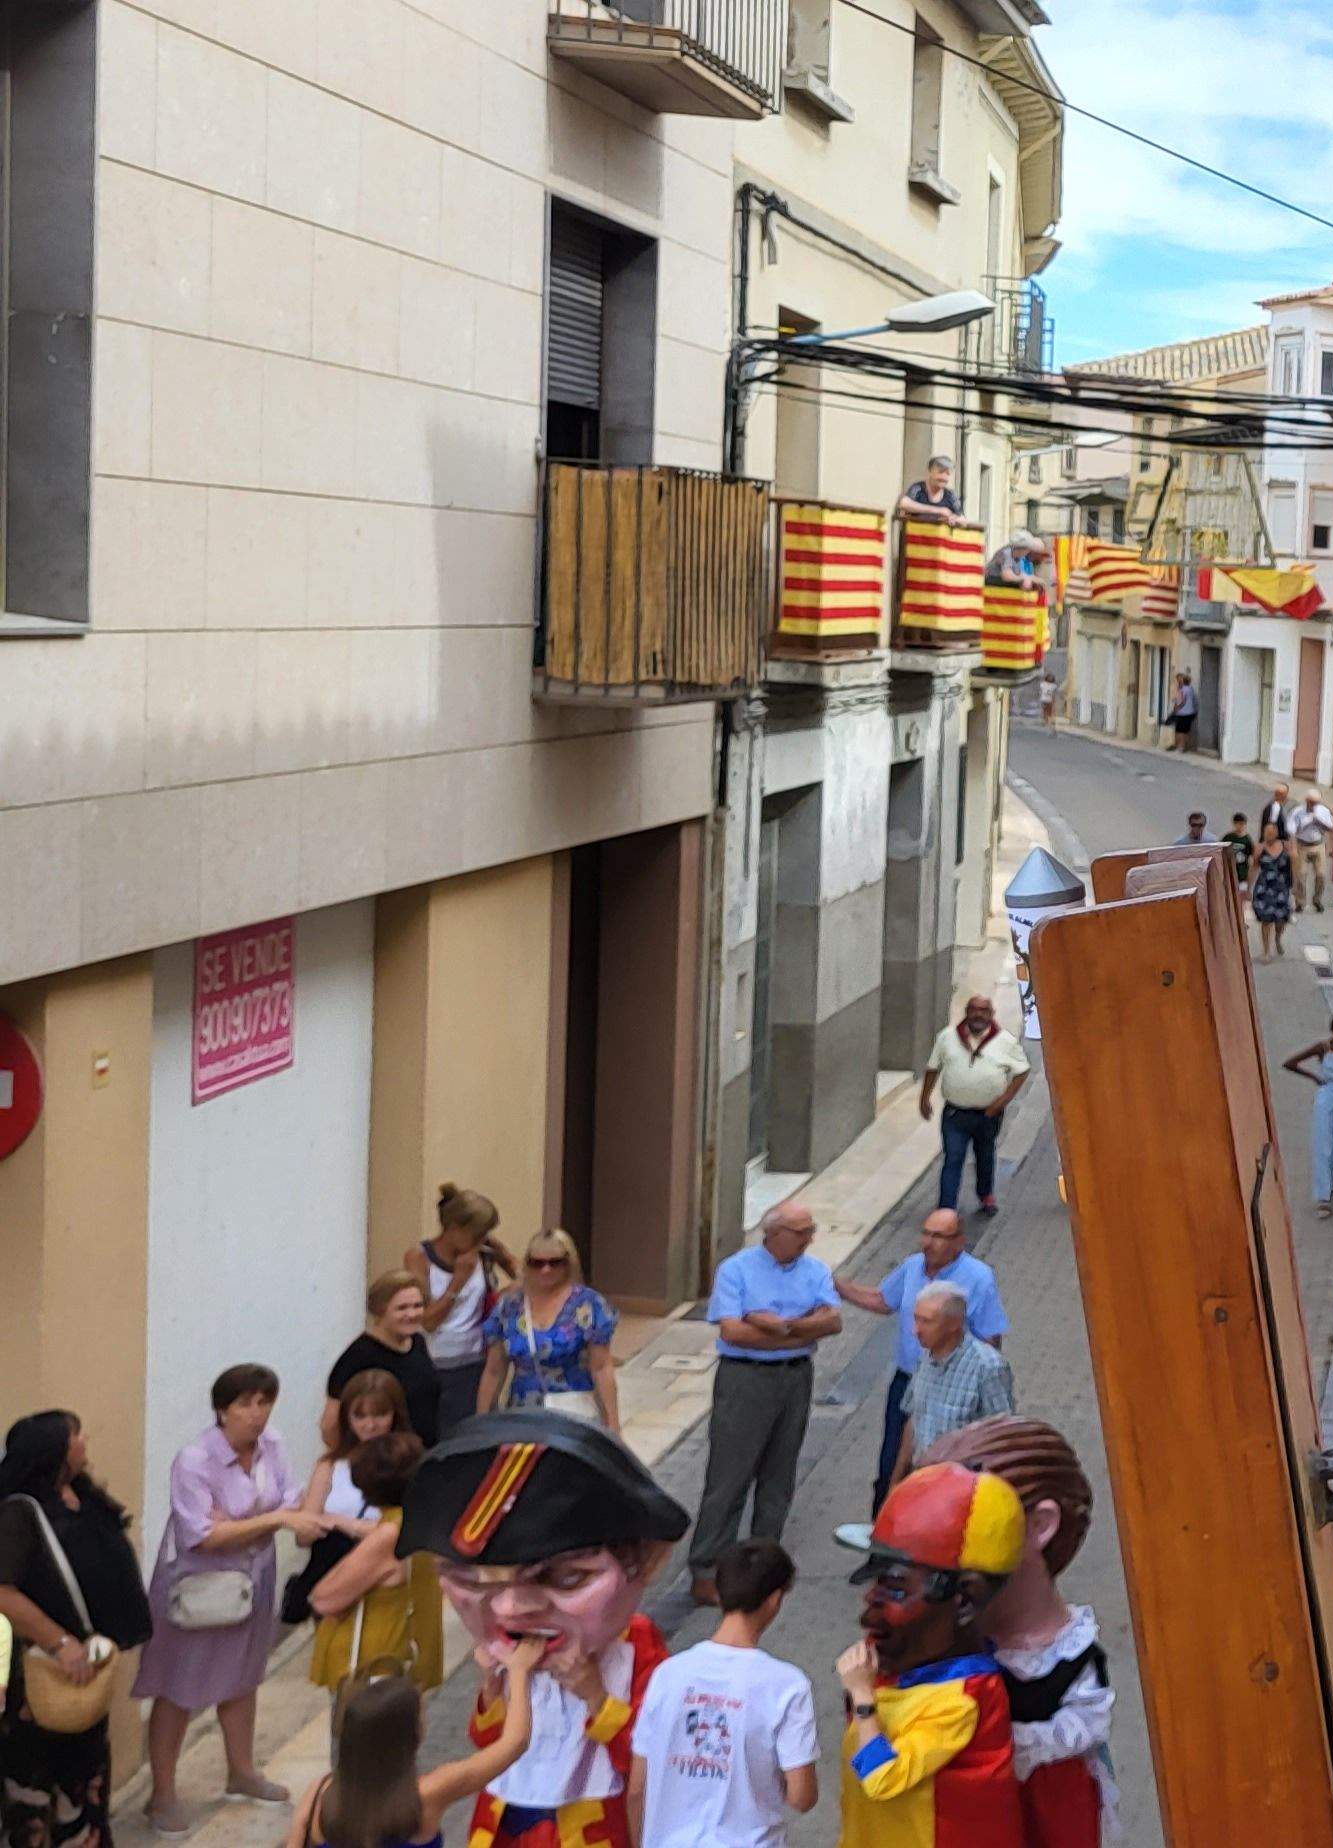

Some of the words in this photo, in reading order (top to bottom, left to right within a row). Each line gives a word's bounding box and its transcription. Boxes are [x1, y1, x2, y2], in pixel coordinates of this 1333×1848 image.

[202, 945, 228, 994] SE
[231, 929, 292, 985] VENDE
[200, 980, 292, 1056] 900907373
